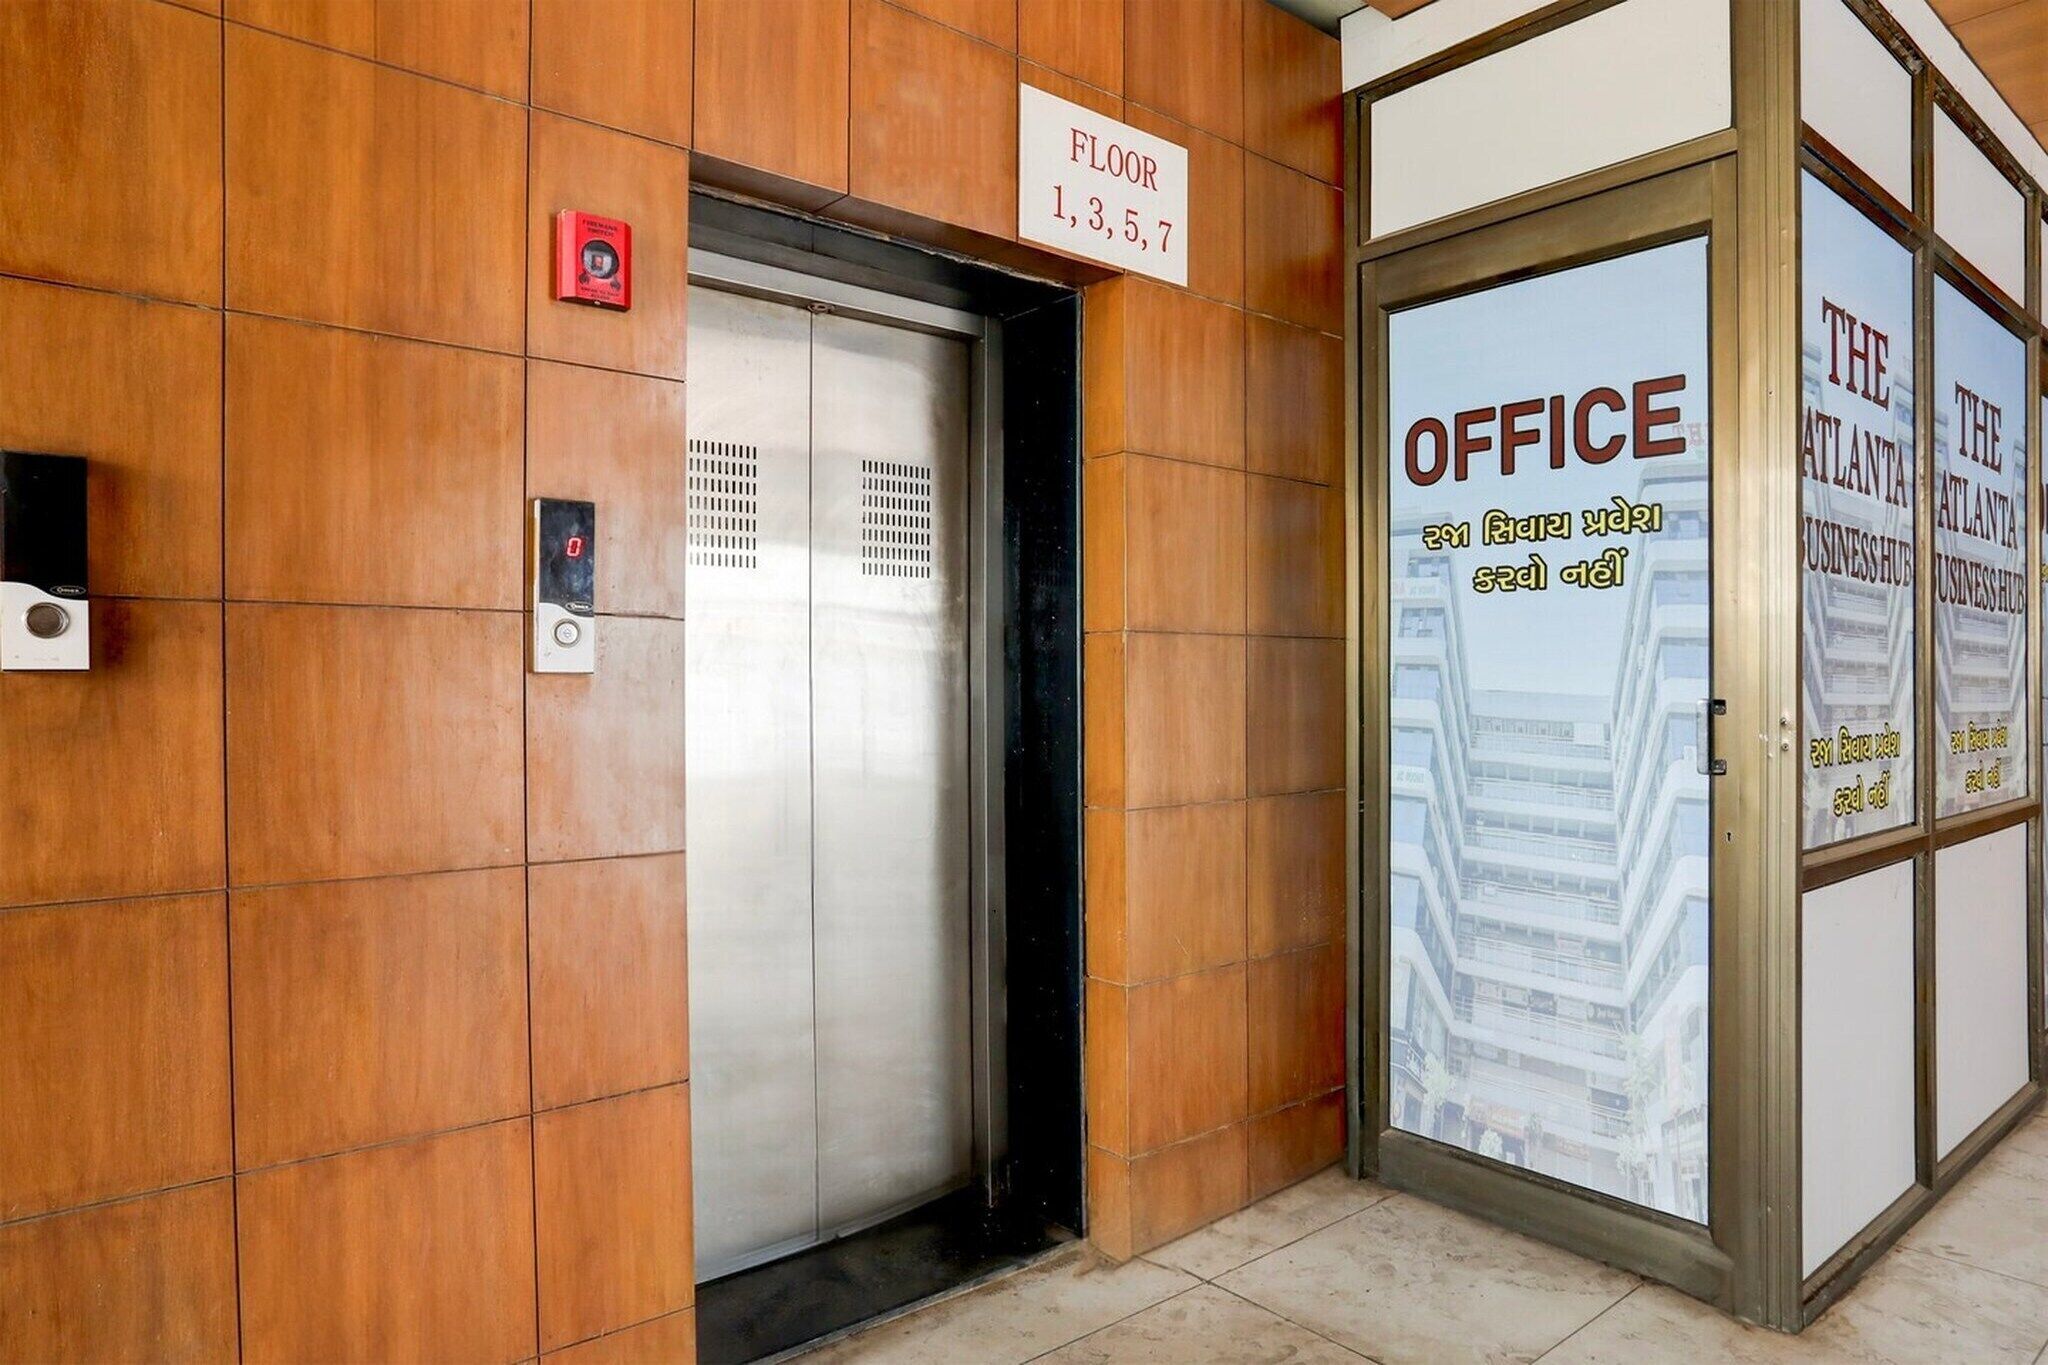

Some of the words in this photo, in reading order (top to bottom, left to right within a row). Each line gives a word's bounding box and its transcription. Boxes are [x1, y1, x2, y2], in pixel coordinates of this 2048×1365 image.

[1070, 127, 1158, 191] FLOOR
[1822, 296, 1890, 411] THE
[1404, 373, 1686, 487] OFFICE
[1801, 405, 1908, 509] ATLANTA
[1955, 380, 2002, 473] THE
[1423, 522, 1470, 550] રજા
[1482, 509, 1571, 546] સિવાય
[1582, 495, 1663, 537] પ્રવેશ
[1937, 469, 2019, 550] ATLANTA
[566, 537, 582, 557] 0
[1473, 554, 1547, 593] કરવો
[1560, 547, 1629, 590] નહીં
[1879, 535, 1913, 587] HUB
[1935, 552, 1996, 613] USINESS
[1998, 569, 2025, 615] HUB
[1810, 737, 1833, 768] રજા
[1838, 726, 1873, 765] સિવાય
[1833, 774, 1864, 817] કરવો
